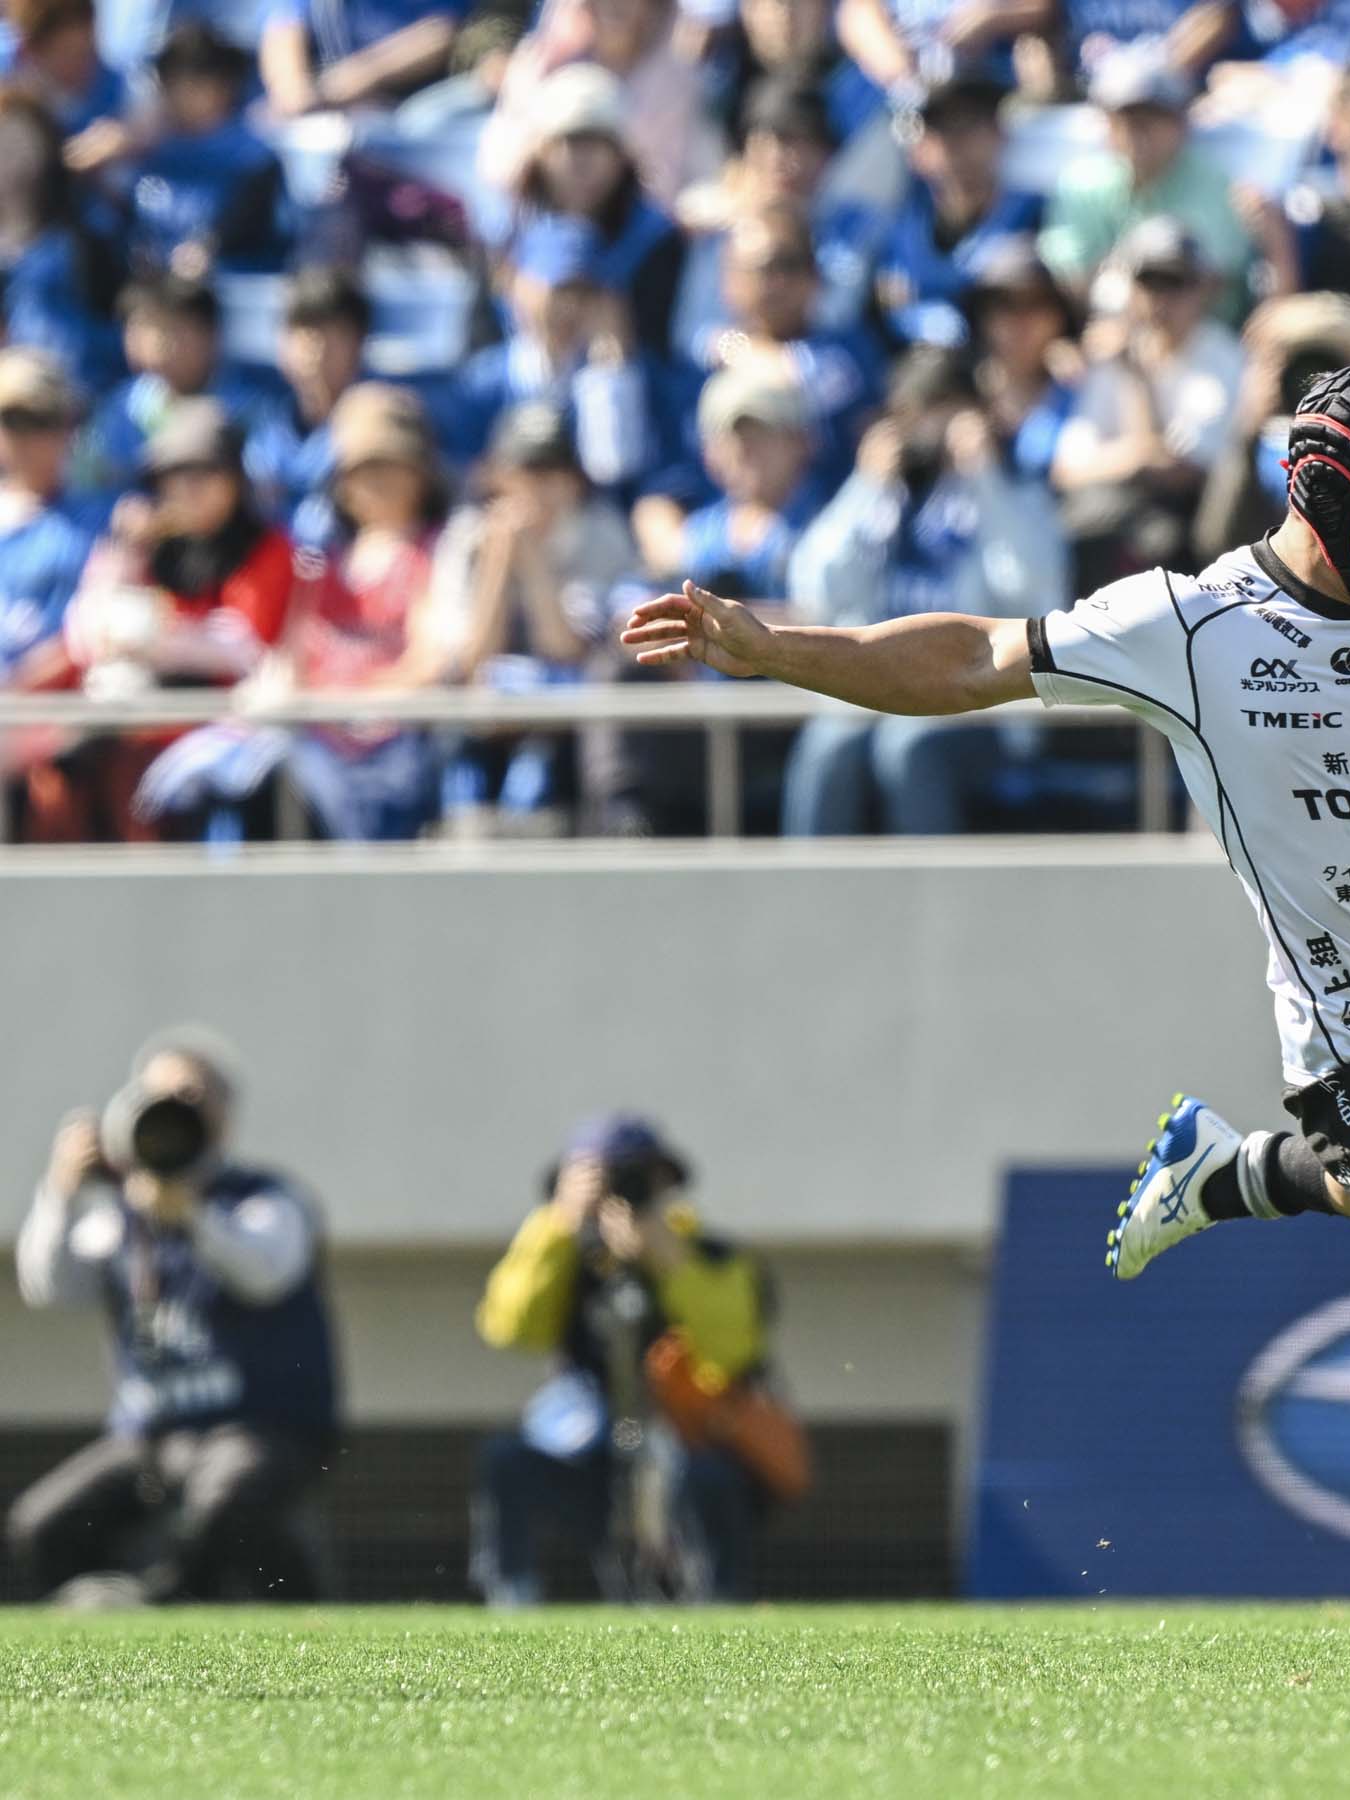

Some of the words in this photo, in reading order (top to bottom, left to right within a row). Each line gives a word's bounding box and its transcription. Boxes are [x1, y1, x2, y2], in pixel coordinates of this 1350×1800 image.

[1240, 679, 1321, 693] 光アルファクス
